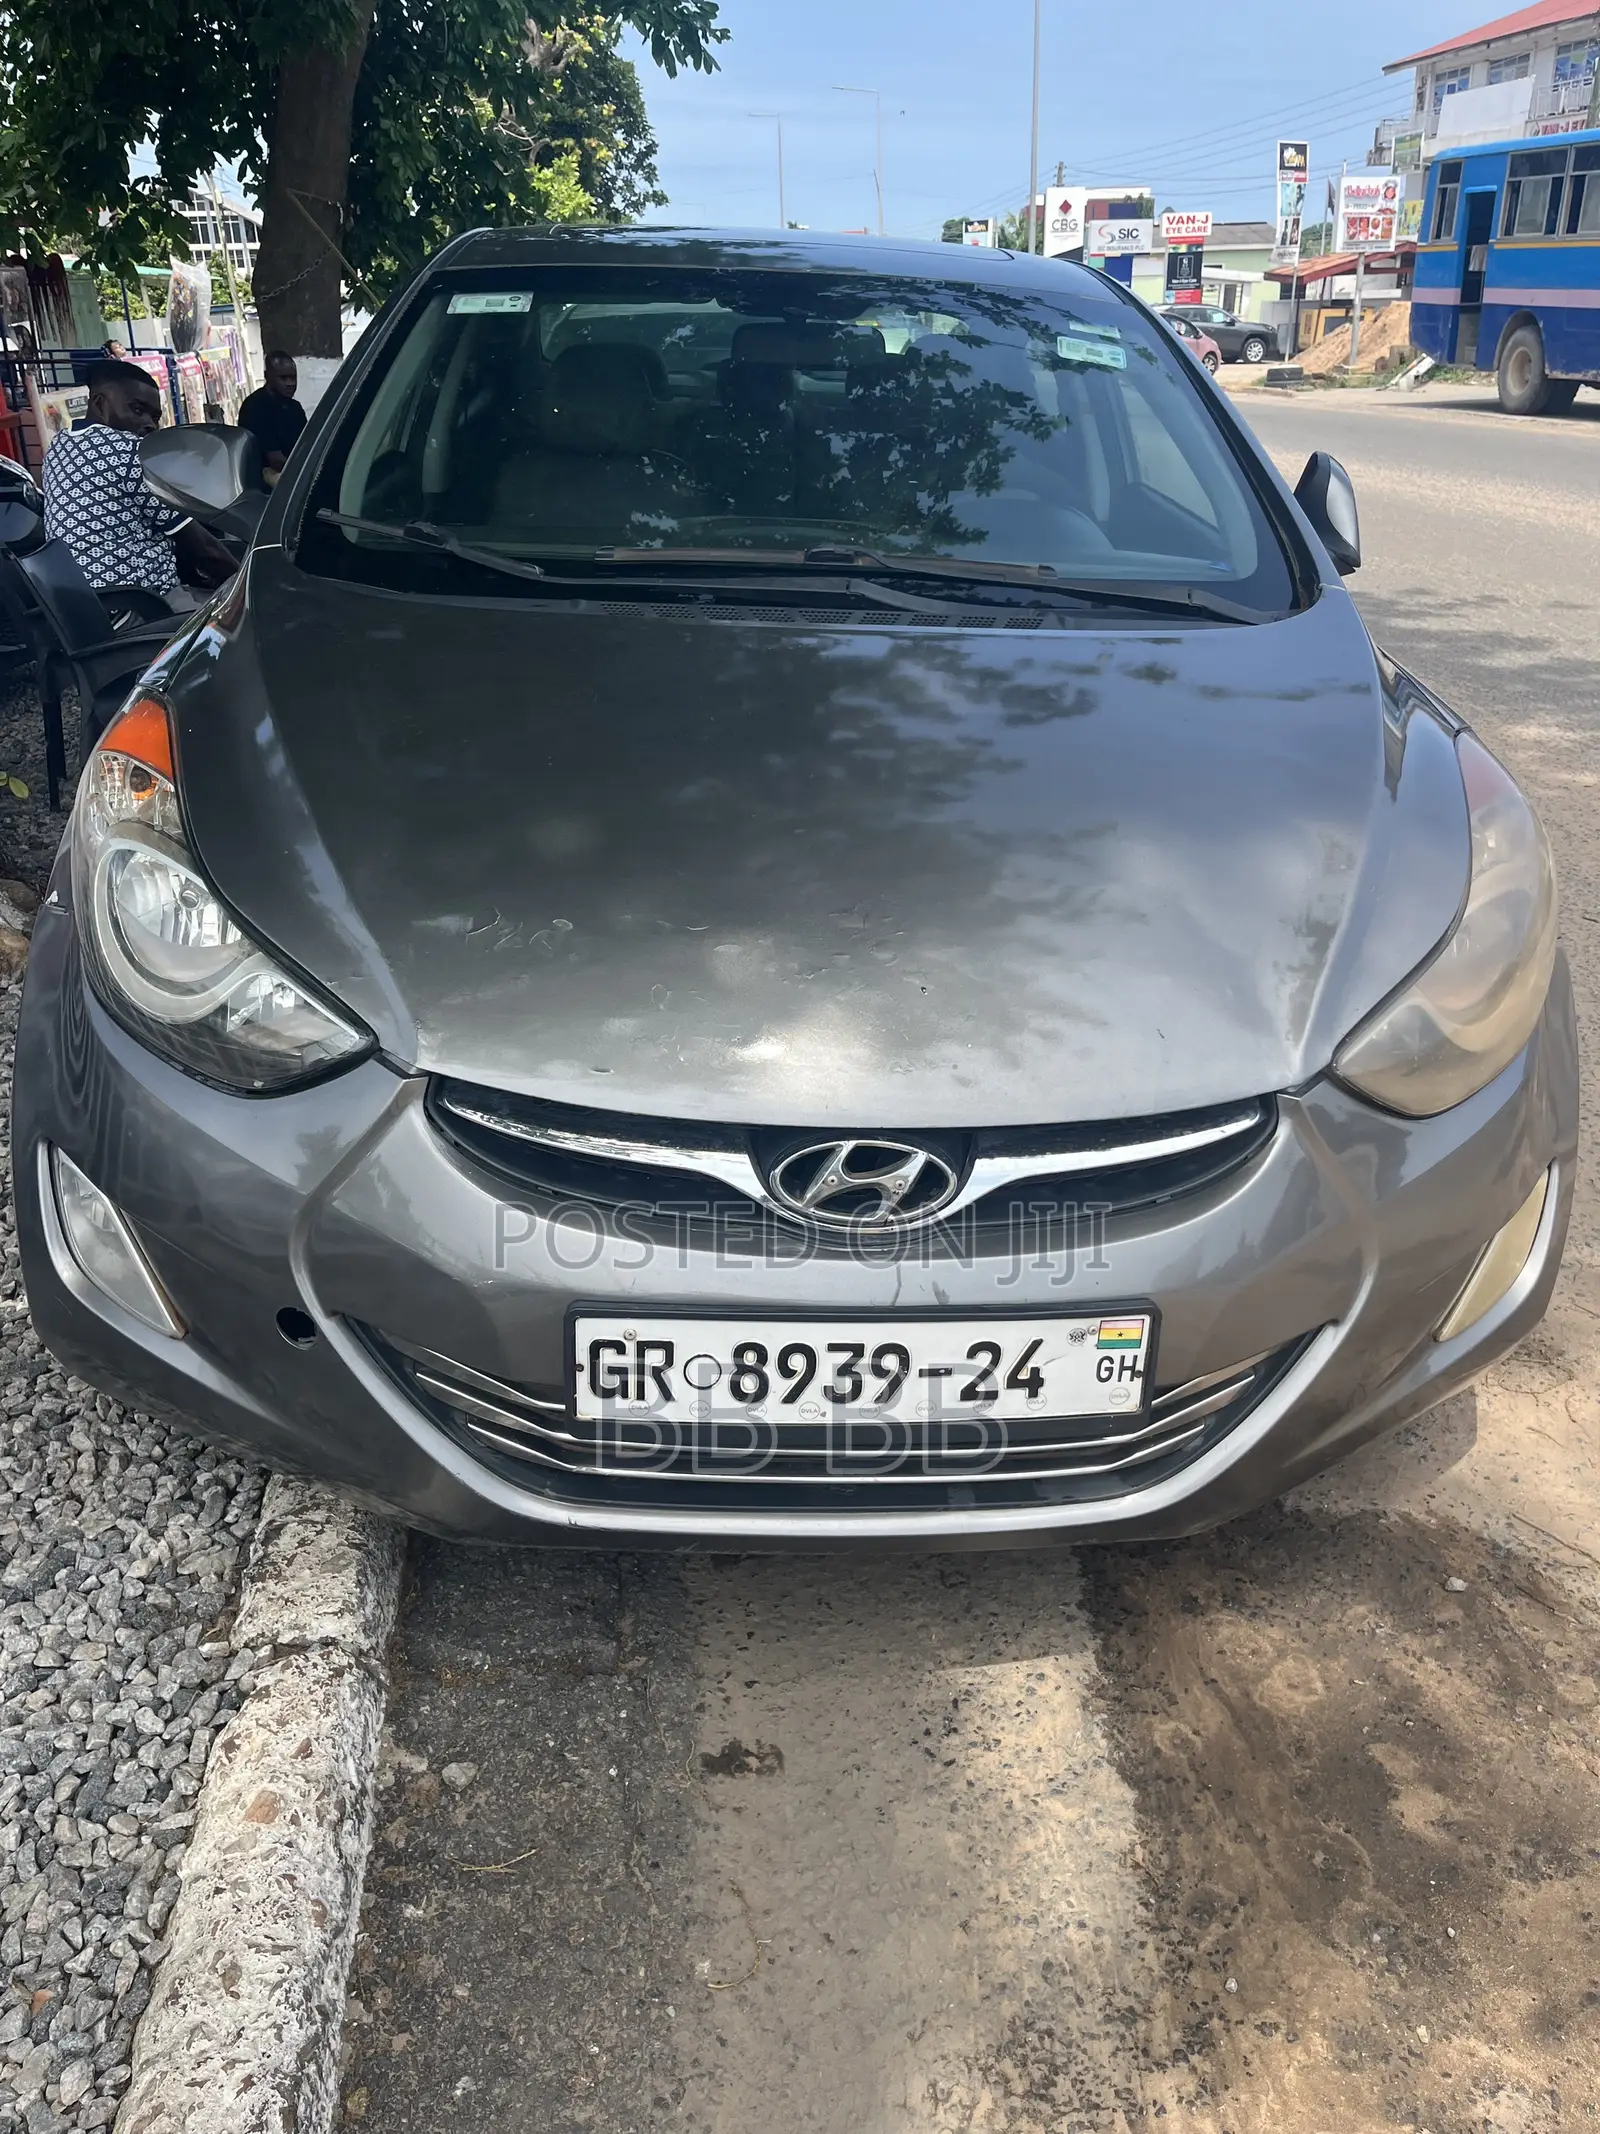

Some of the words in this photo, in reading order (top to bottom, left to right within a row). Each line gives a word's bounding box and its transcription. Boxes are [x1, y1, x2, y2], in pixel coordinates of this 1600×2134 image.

[1051, 218, 1079, 231] CBG
[1166, 214, 1209, 226] VAN-J
[1118, 227, 1140, 239] SIC
[1165, 226, 1183, 235] EYE
[1185, 225, 1209, 234] CARE
[587, 1338, 676, 1404] GR
[729, 1336, 1045, 1405] 8939-24
[1095, 1354, 1139, 1383] GH
[800, 1407, 819, 1415] DVLA
